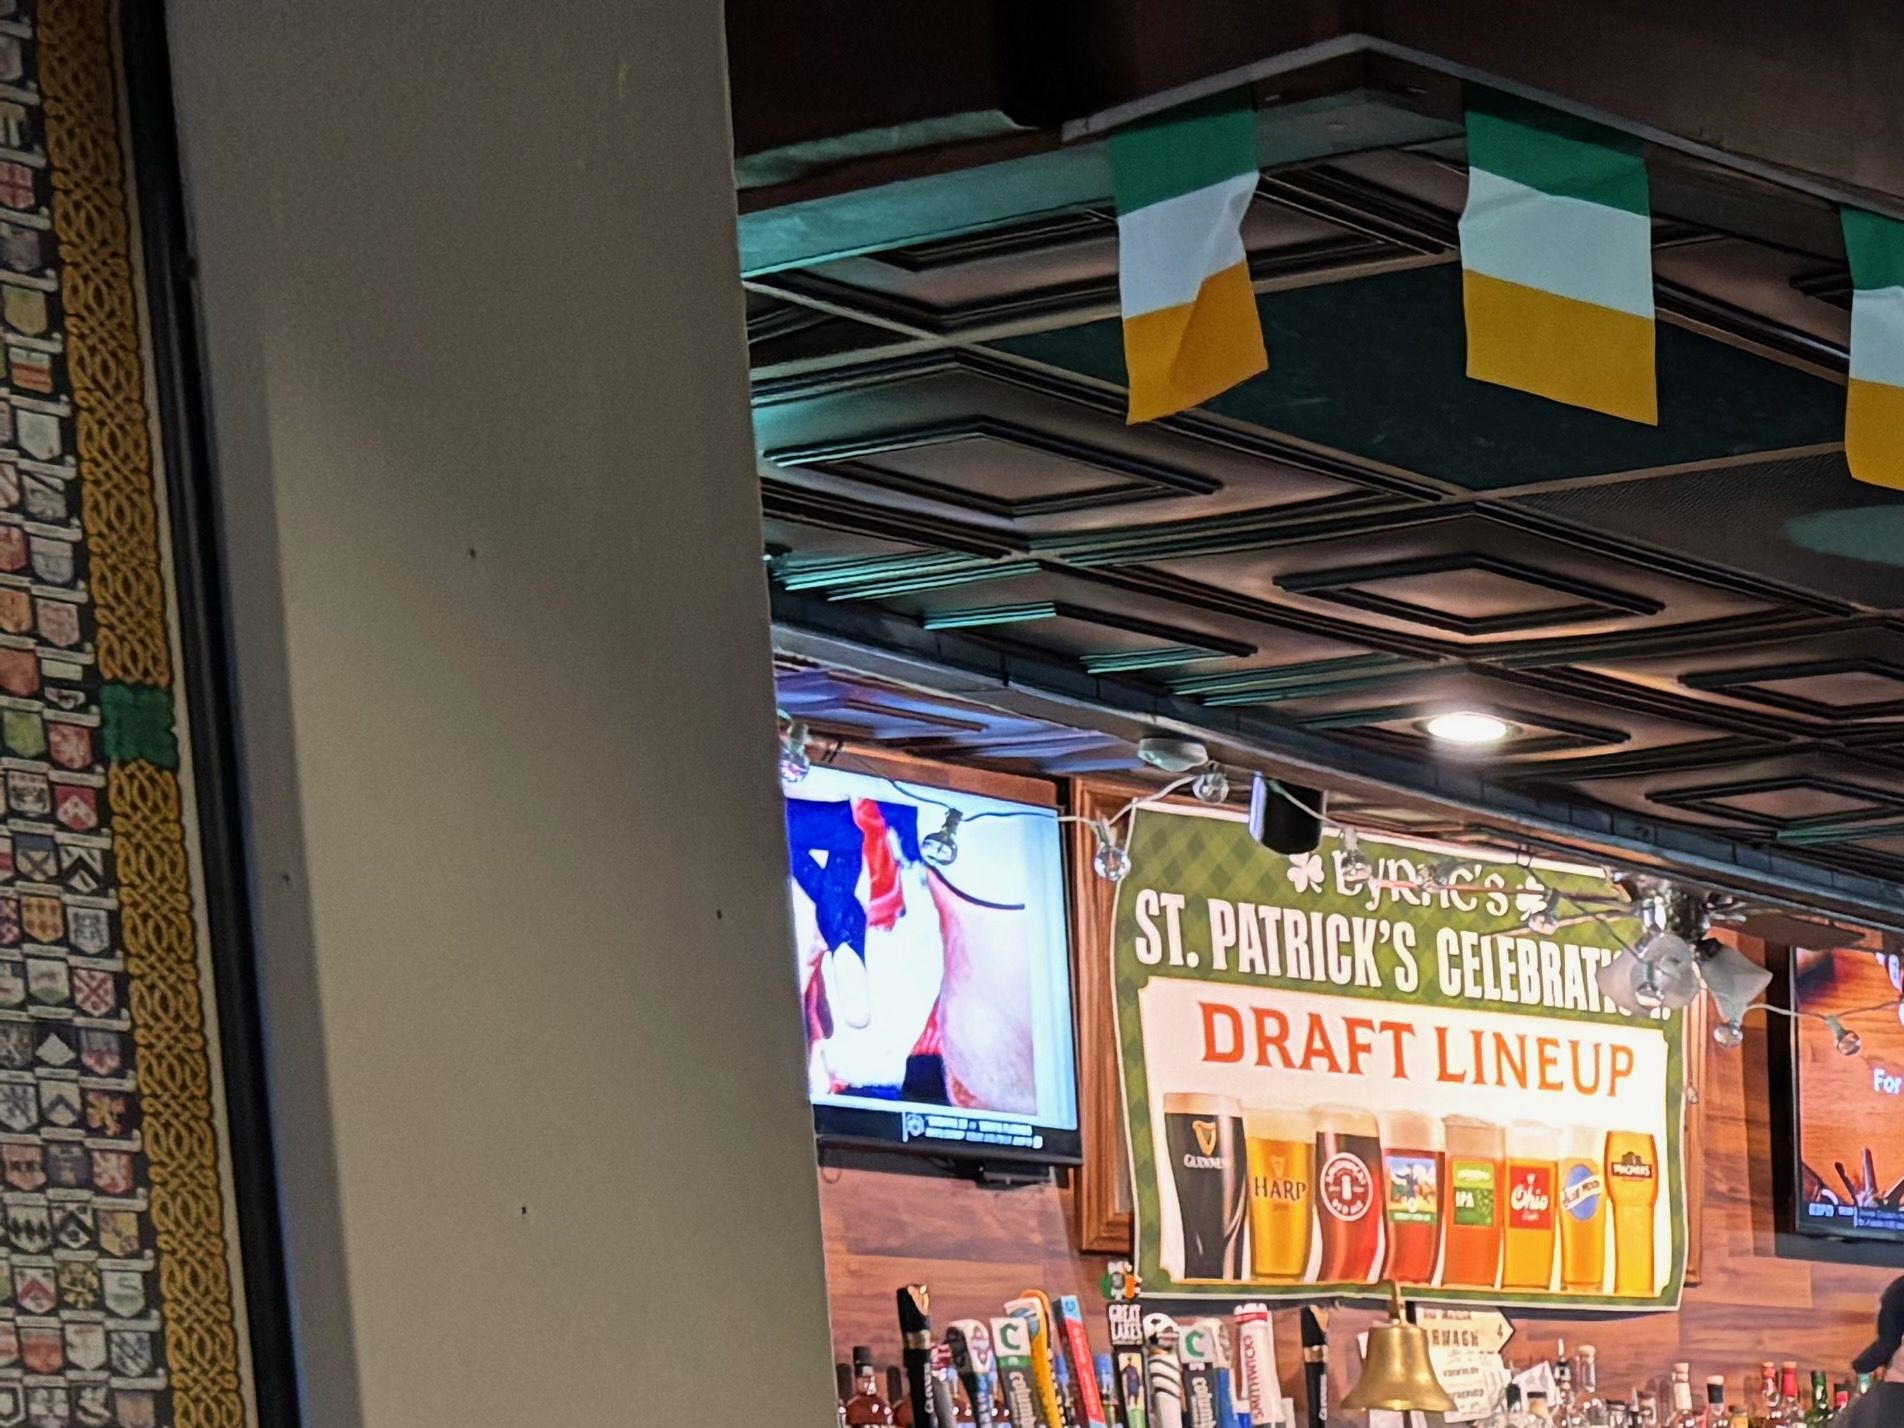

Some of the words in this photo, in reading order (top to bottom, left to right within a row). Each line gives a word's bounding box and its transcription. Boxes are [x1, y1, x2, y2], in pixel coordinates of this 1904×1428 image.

[1134, 889, 1199, 968] ST.
[1208, 899, 1419, 993] PATRICK'S
[1198, 1001, 1414, 1080] DRAFT
[1435, 1026, 1636, 1098] LINEUP
[1873, 1068, 1902, 1093] For
[1254, 1176, 1308, 1201] HARP
[1455, 1191, 1476, 1209] IPA
[1510, 1183, 1549, 1212] Ohio
